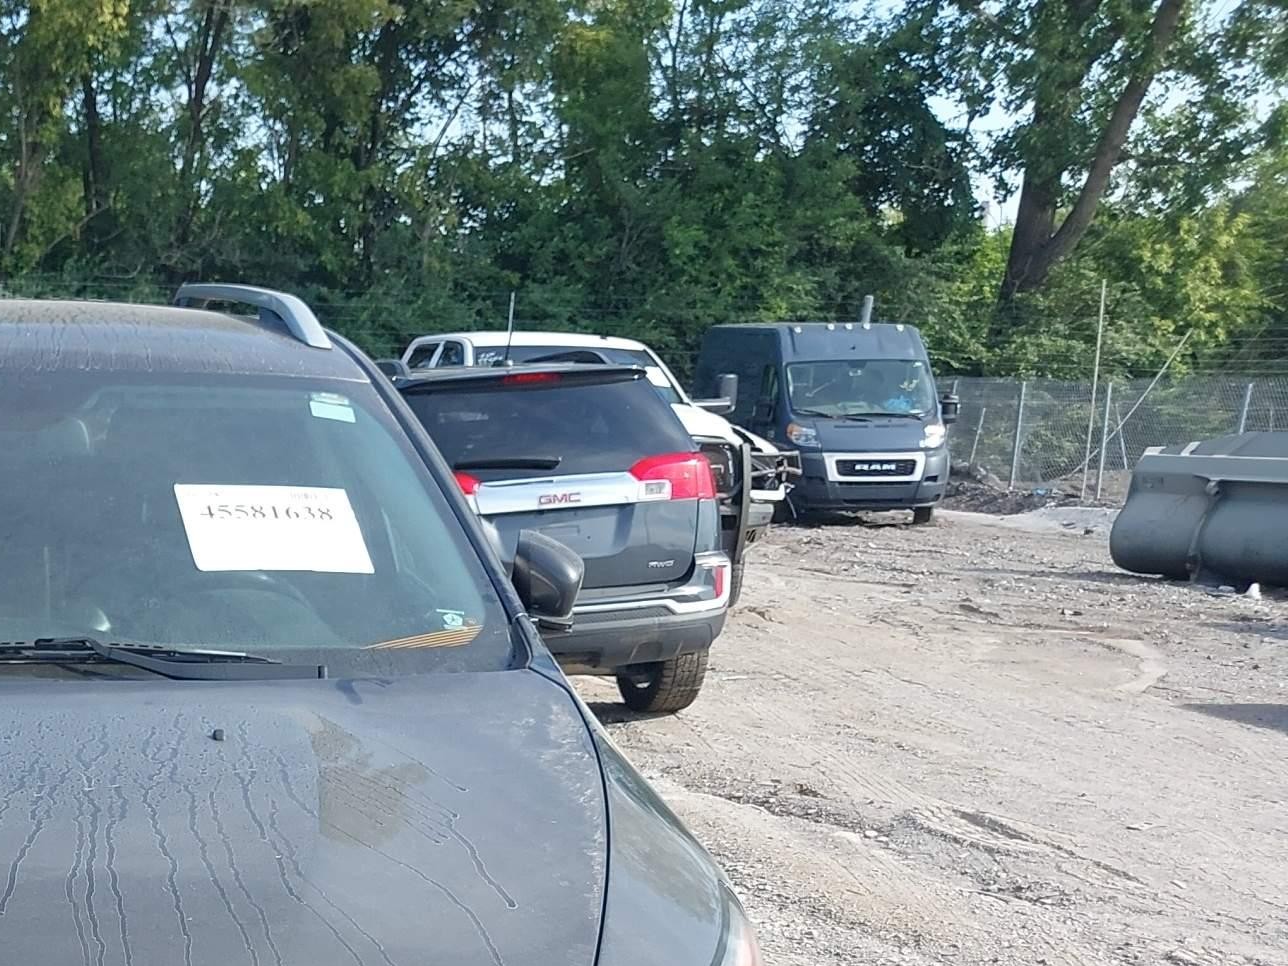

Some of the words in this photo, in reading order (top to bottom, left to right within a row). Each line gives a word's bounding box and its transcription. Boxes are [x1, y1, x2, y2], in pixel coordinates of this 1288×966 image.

[855, 463, 896, 471] RAM
[539, 492, 581, 505] GMC
[200, 505, 333, 520] 45581638
